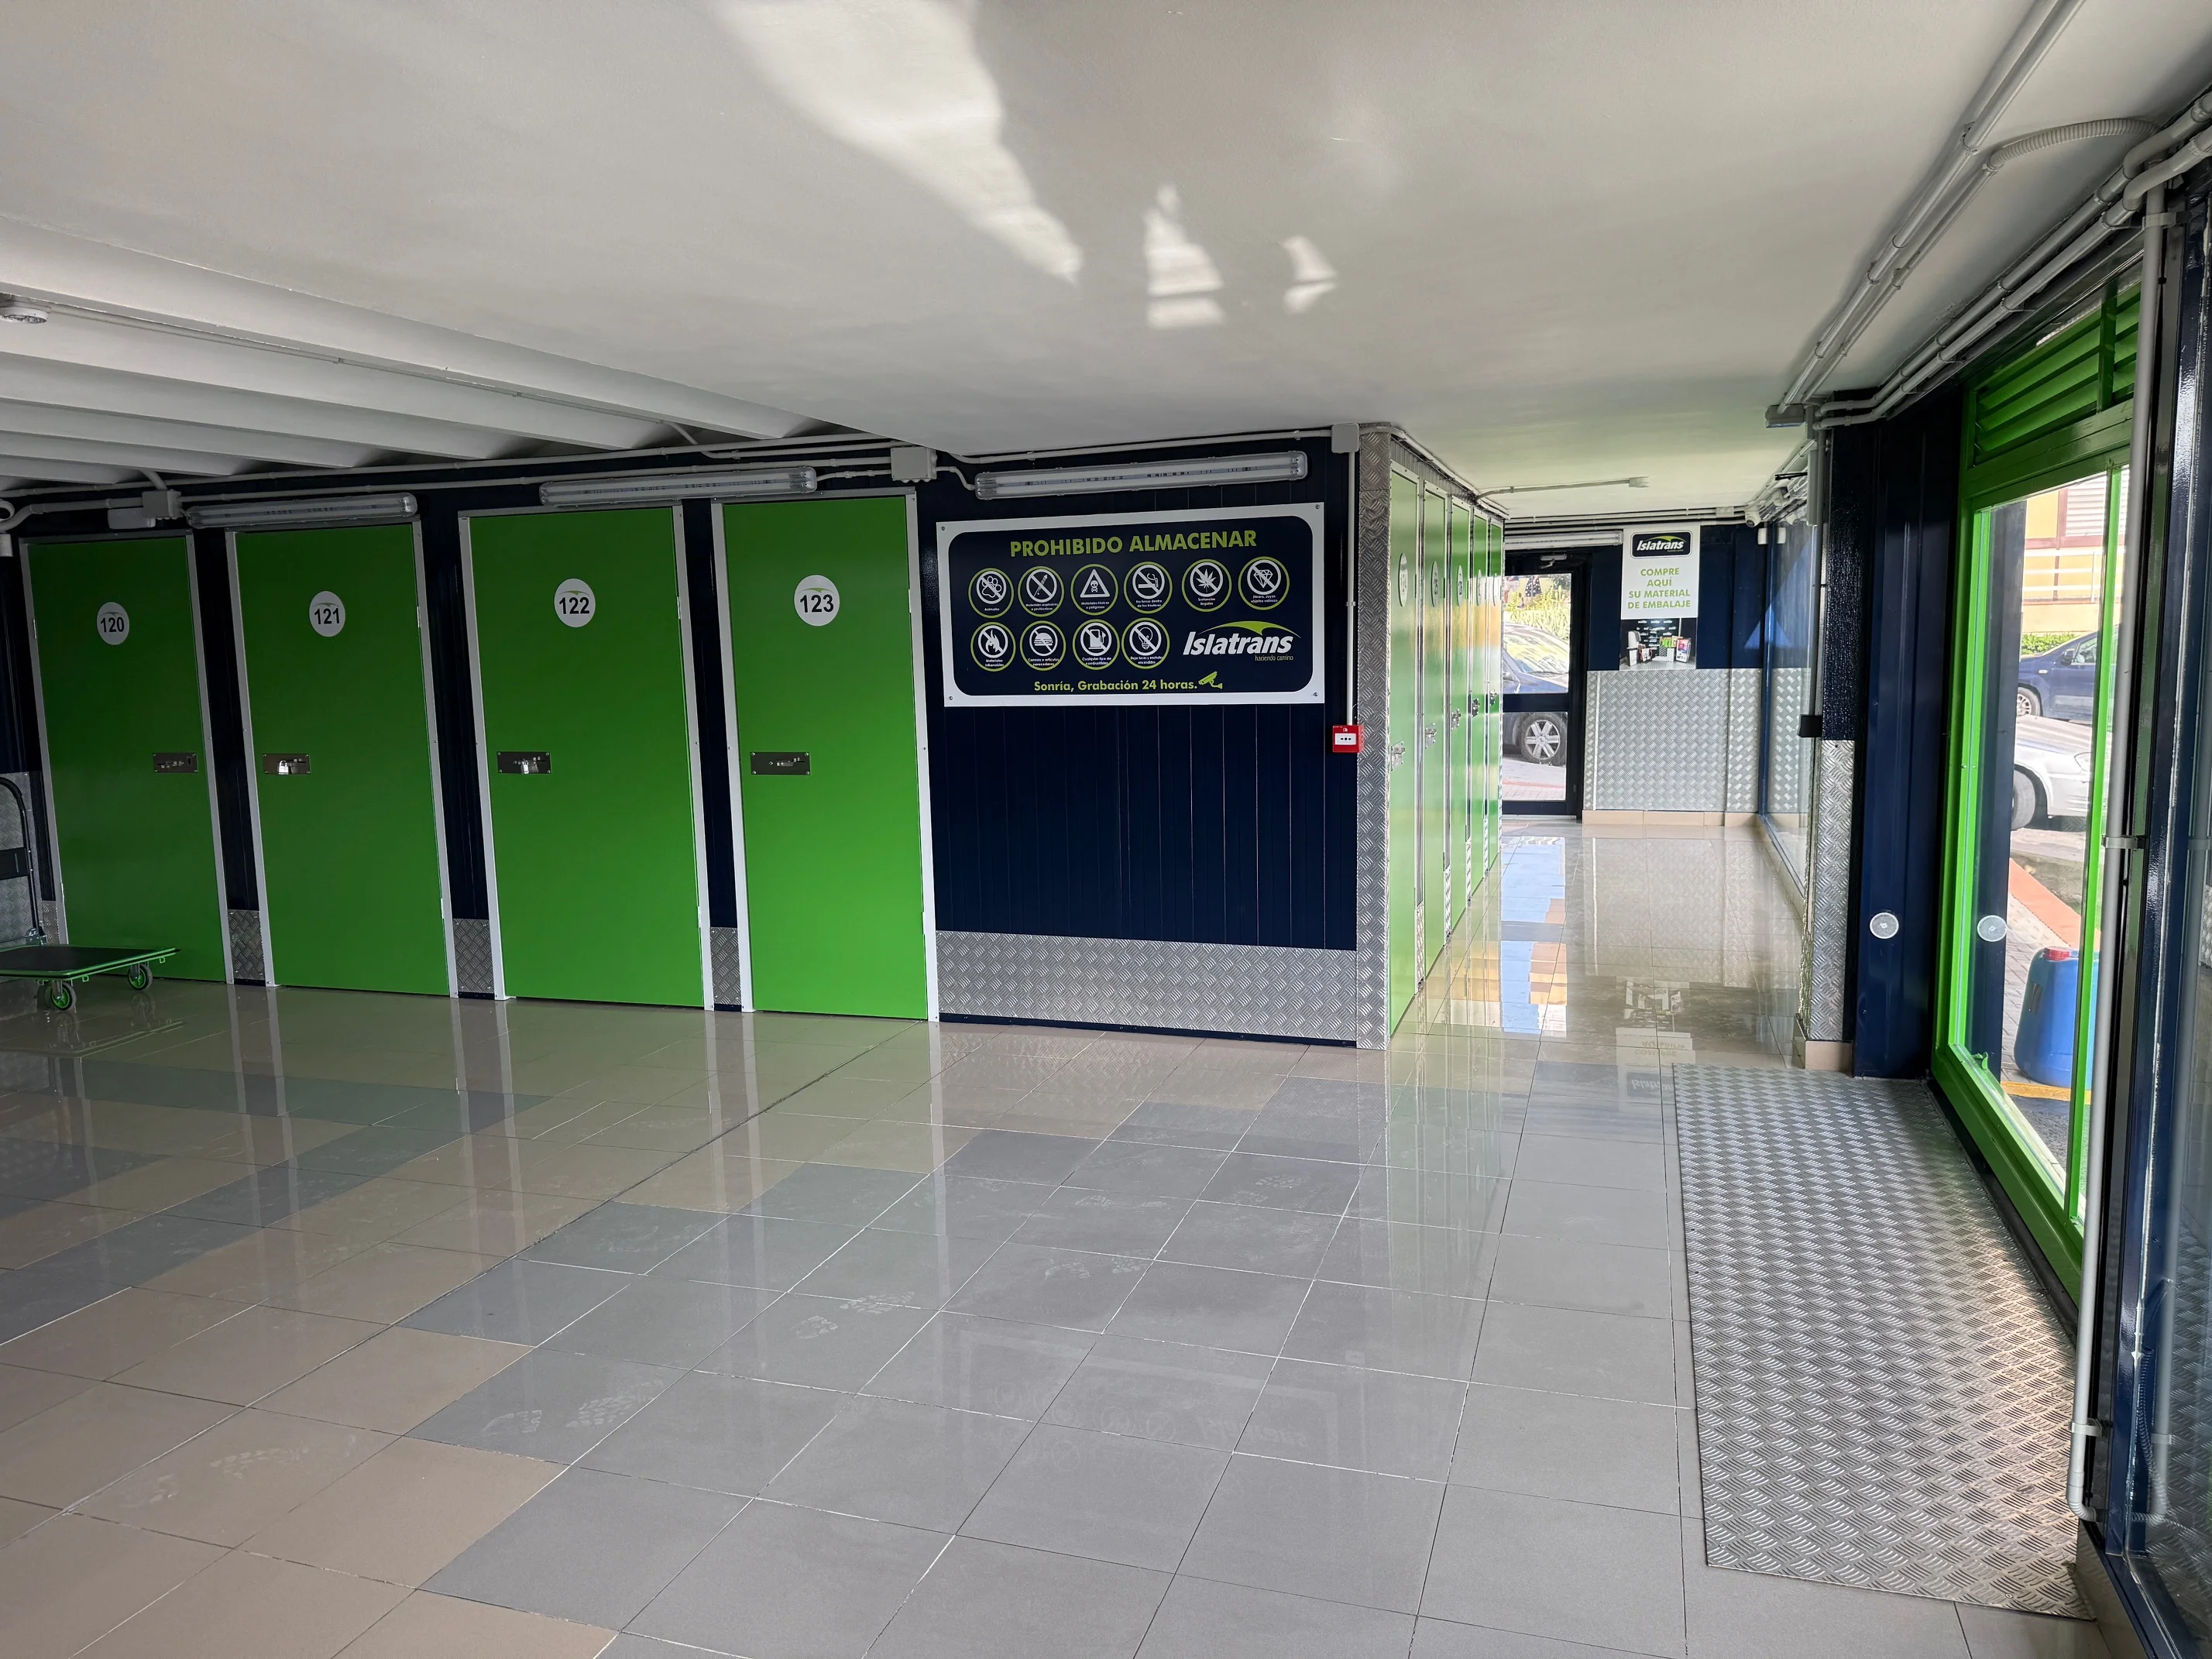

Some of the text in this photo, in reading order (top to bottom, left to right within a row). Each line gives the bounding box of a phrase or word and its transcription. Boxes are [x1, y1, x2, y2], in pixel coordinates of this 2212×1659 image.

[1010, 530, 1257, 557] PROHIBIDO ALMACENAR
[1636, 540, 1685, 551] Islatrans
[1640, 568, 1680, 576] COMPRE
[1647, 576, 1673, 588] AQUÍ
[1628, 589, 1691, 599] SU MATERIAL
[558, 596, 590, 614] 122
[799, 594, 834, 613] 123
[1627, 599, 1691, 610] DE EMBALAJE
[314, 607, 341, 625] 121
[100, 617, 125, 634] 120
[1183, 631, 1294, 655] Islatrans
[1034, 678, 1198, 692] Sonría, Grabación 24 horas.
